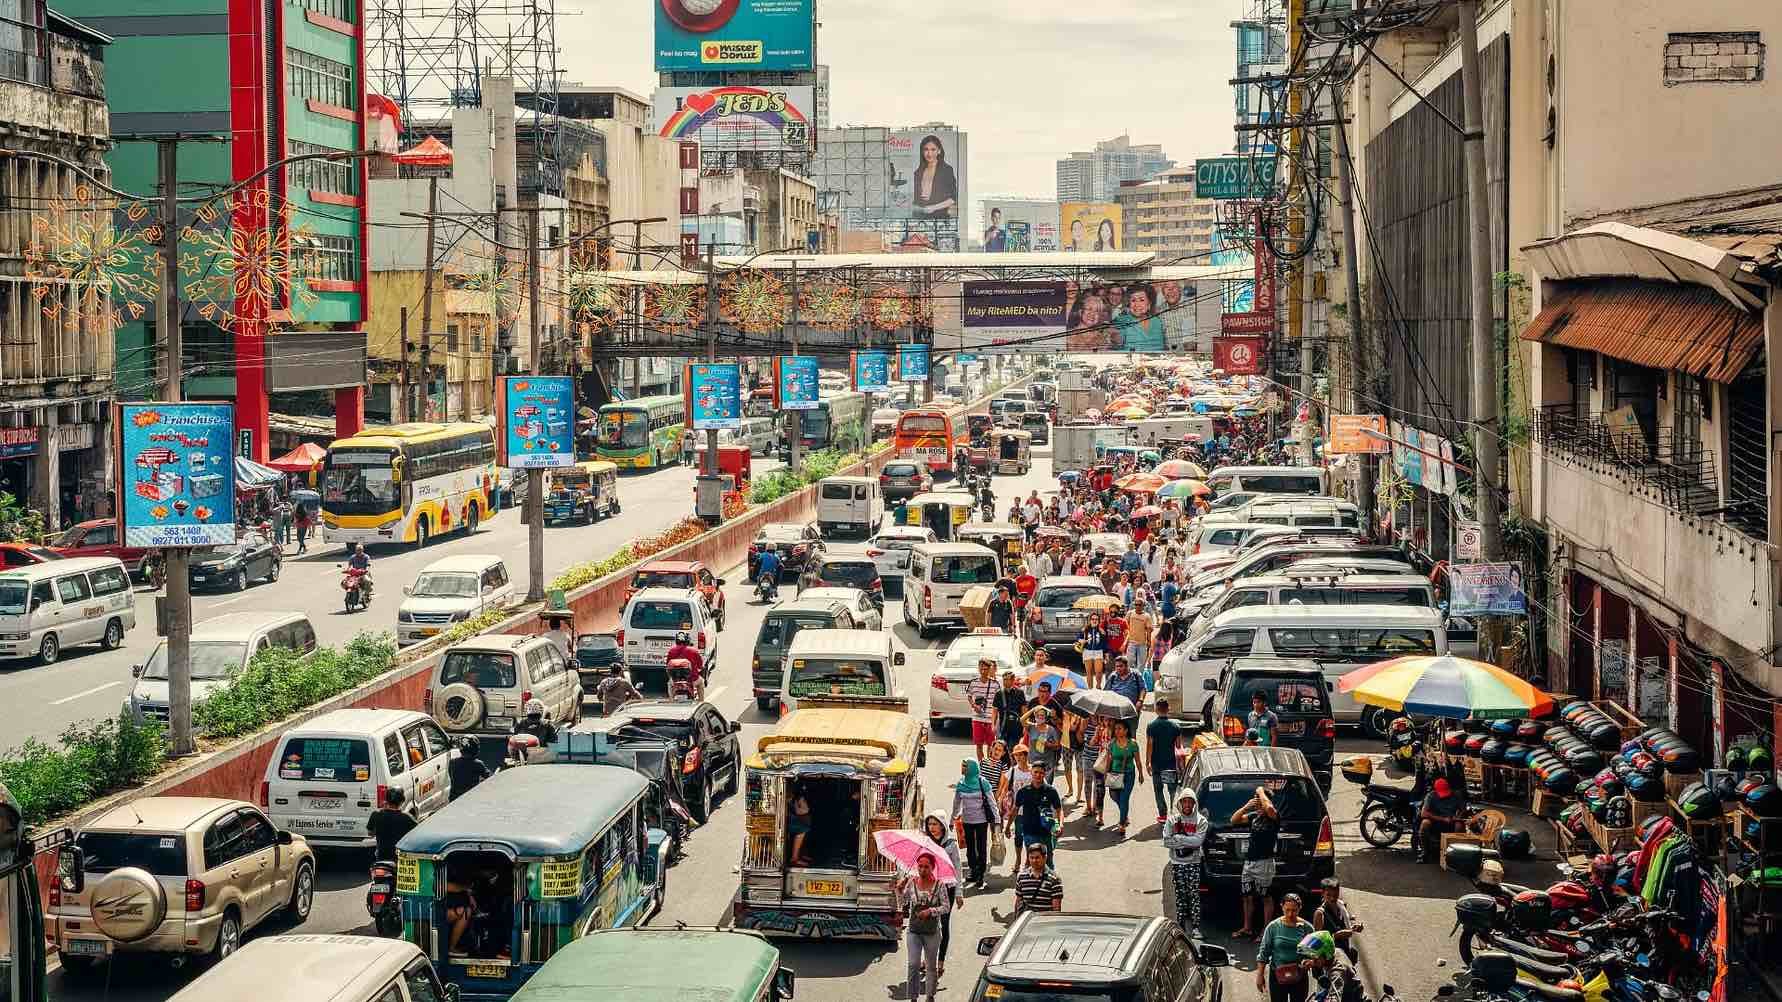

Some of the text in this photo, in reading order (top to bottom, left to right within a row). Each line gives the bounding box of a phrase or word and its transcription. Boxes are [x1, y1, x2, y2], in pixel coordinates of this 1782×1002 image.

[786, 127, 806, 139] 24
[967, 306, 1064, 317] May RiteMED ba nito?
[1223, 316, 1274, 328] PAWNSHOP
[916, 447, 947, 455] MA ROSE
[164, 527, 179, 536] 563
